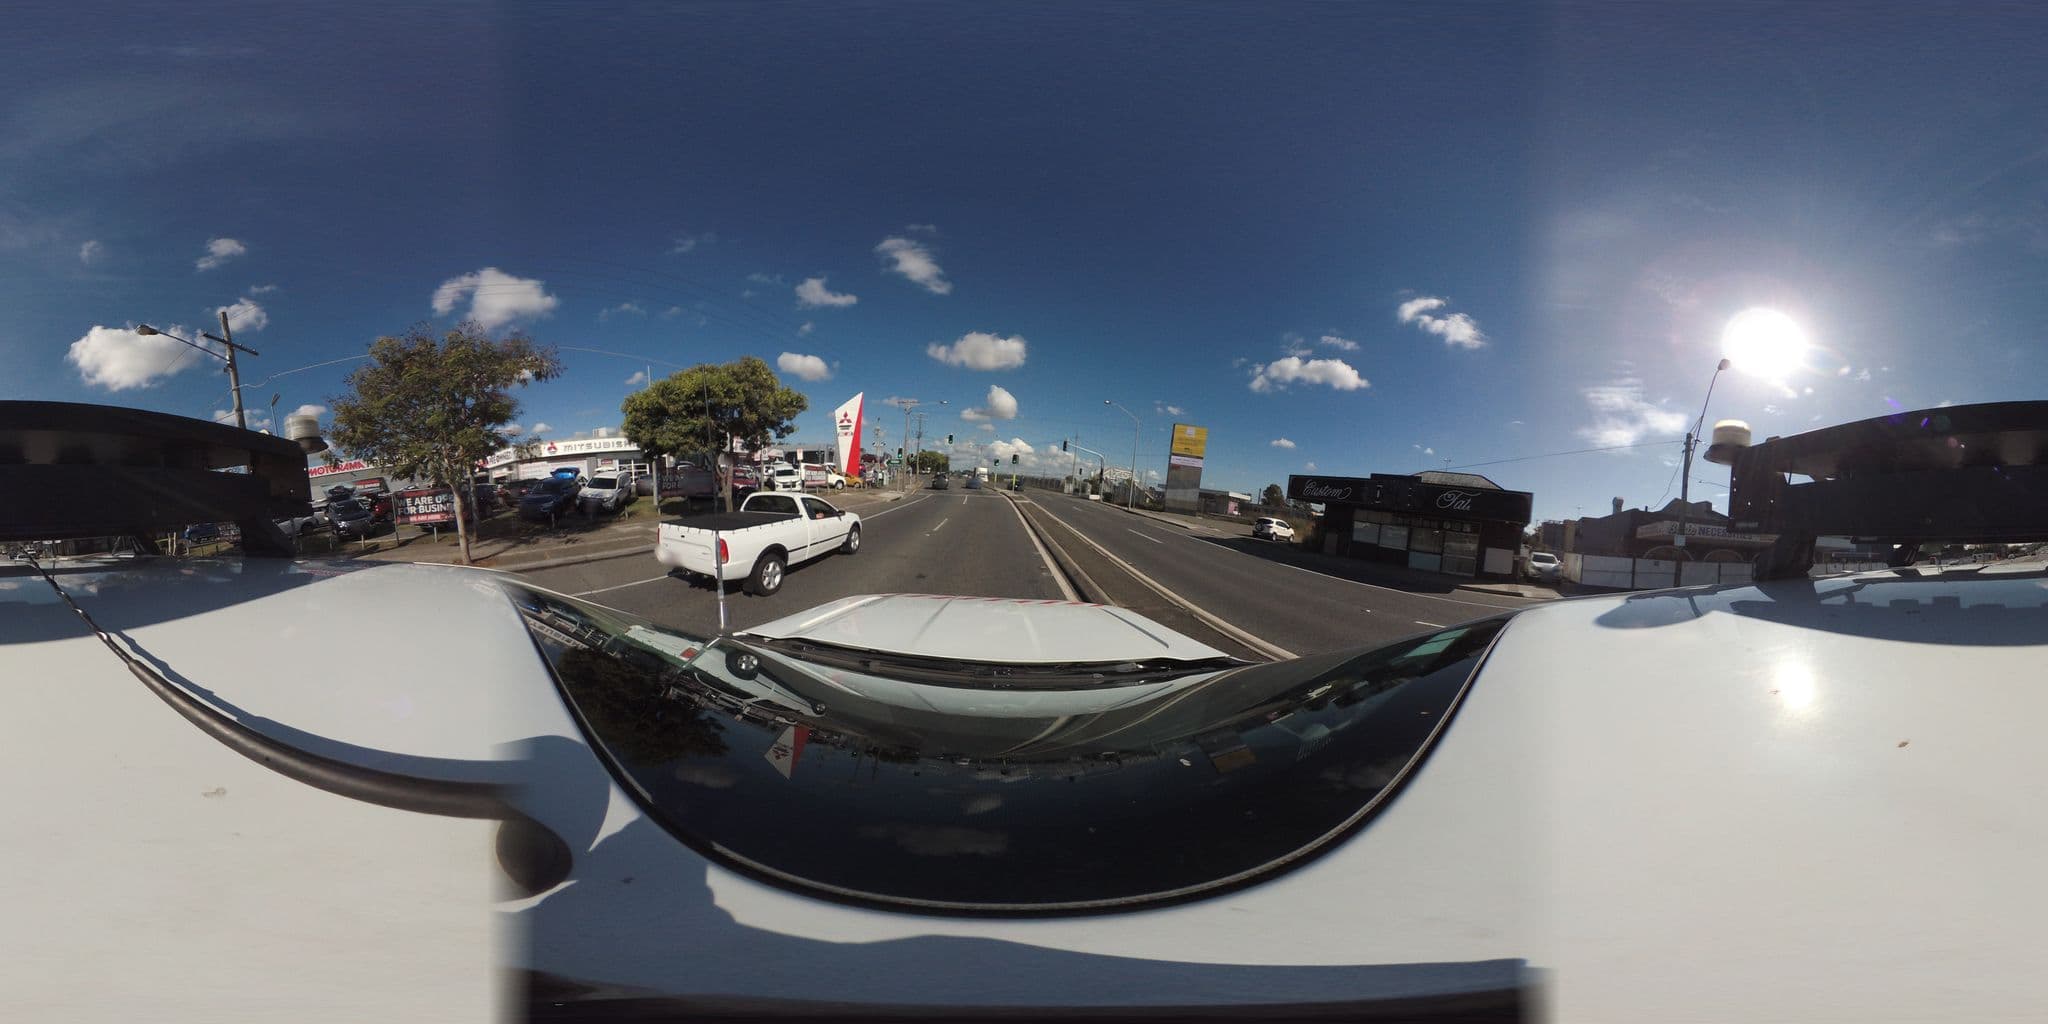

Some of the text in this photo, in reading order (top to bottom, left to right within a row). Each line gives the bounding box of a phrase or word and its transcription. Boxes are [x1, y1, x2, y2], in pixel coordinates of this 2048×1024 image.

[1303, 480, 1352, 500] Custom
[414, 495, 433, 506] ARE
[435, 492, 455, 504] OPE
[397, 502, 455, 515] FOR BUSINE
